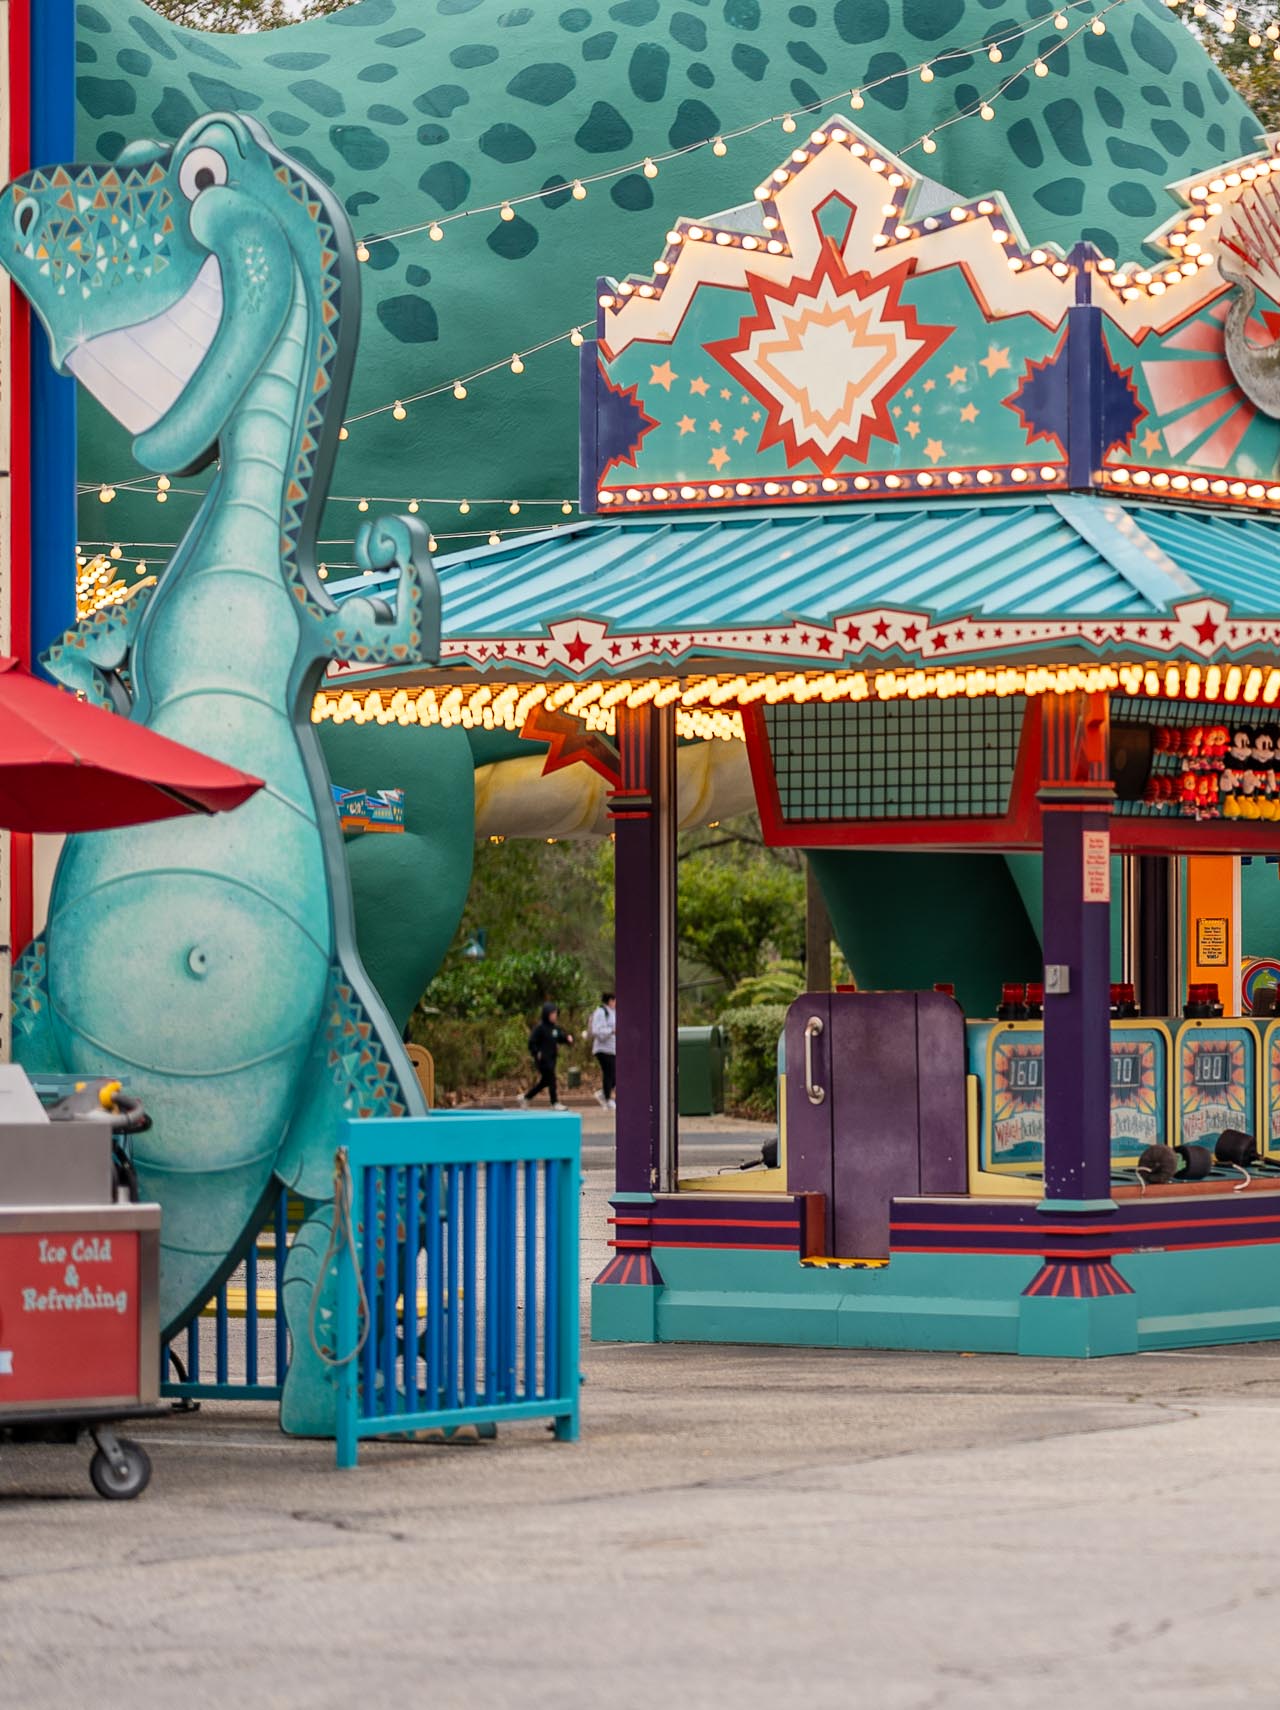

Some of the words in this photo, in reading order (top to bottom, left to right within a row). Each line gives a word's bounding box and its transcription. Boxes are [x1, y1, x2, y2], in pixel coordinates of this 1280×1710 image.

[38, 1238, 66, 1263] Ice
[71, 1237, 112, 1263] Cold
[64, 1264, 79, 1288] &
[21, 1285, 128, 1314] Refreshing
